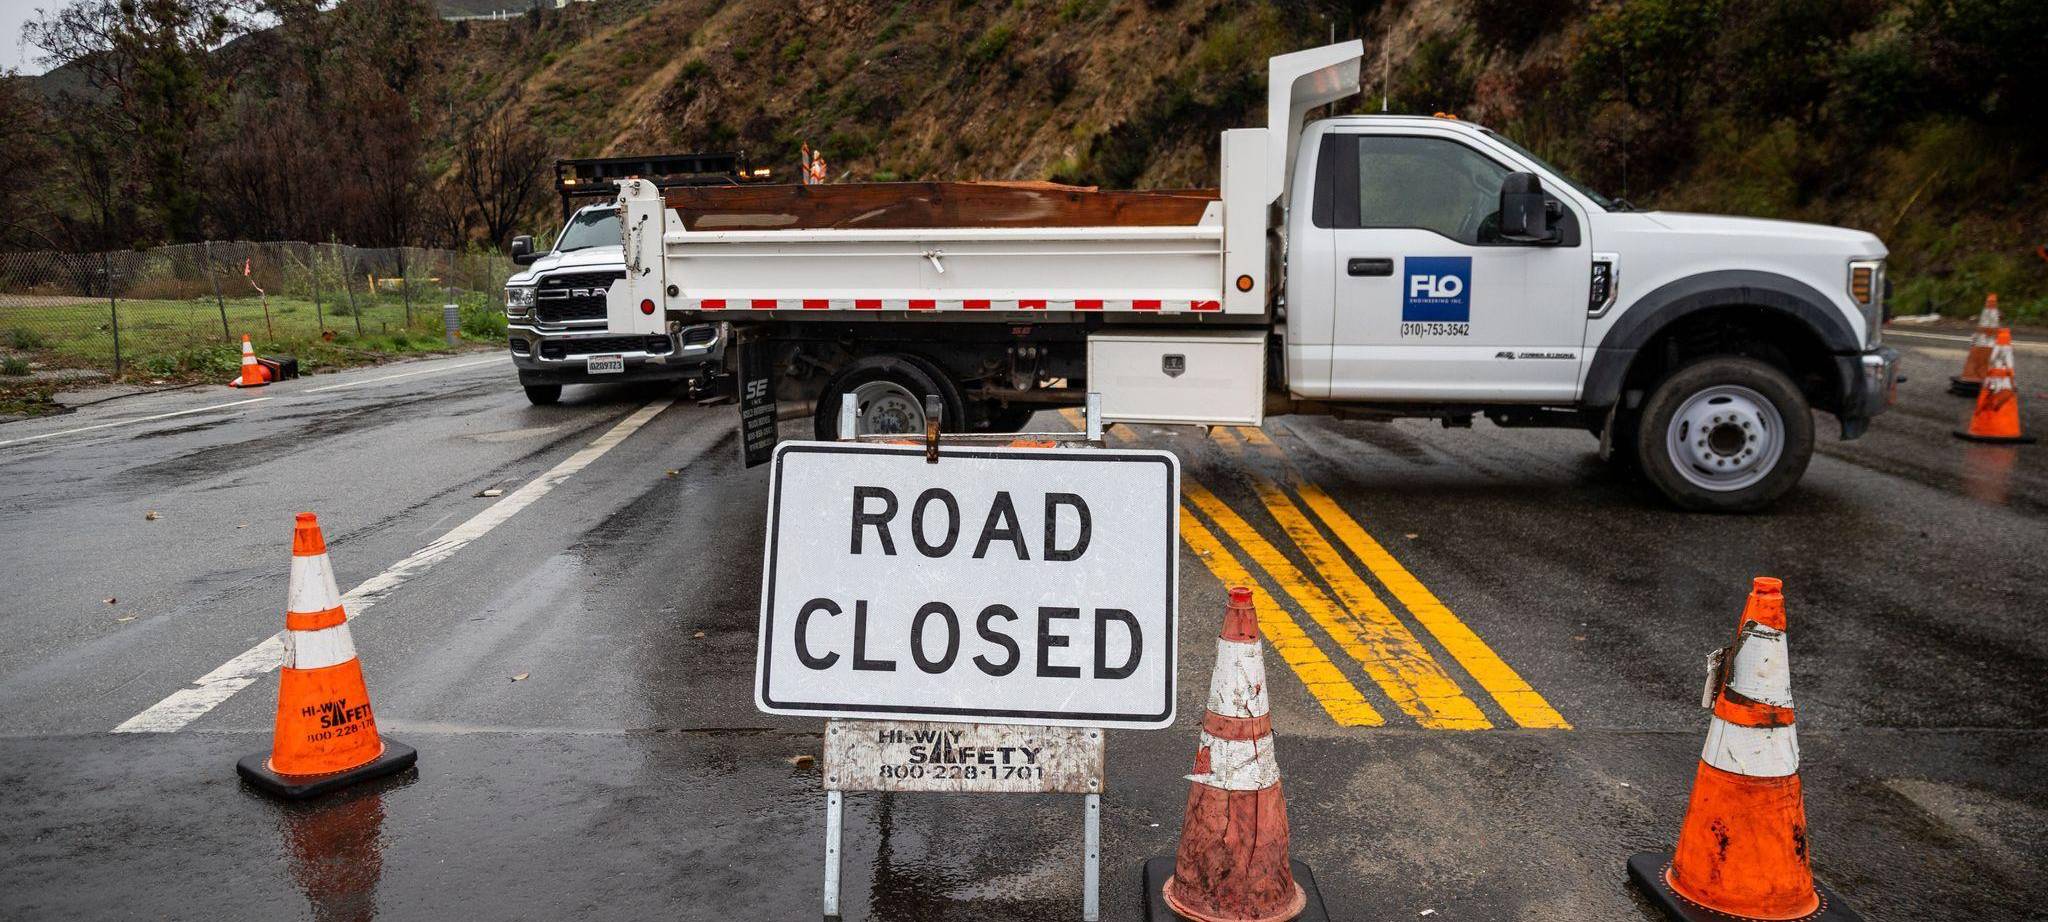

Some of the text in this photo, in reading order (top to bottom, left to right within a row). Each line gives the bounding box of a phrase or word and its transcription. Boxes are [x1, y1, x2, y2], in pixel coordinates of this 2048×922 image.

[572, 288, 608, 297] RA
[1410, 274, 1464, 298] FLO
[1400, 323, 1470, 339] (310)-753-3542
[746, 378, 769, 400] SE
[850, 485, 1093, 563] ROAD
[794, 597, 1143, 681] CLOSED
[302, 698, 346, 717] HI-WAY
[878, 730, 964, 745] HI-WAY
[908, 745, 1044, 765] SAFETY
